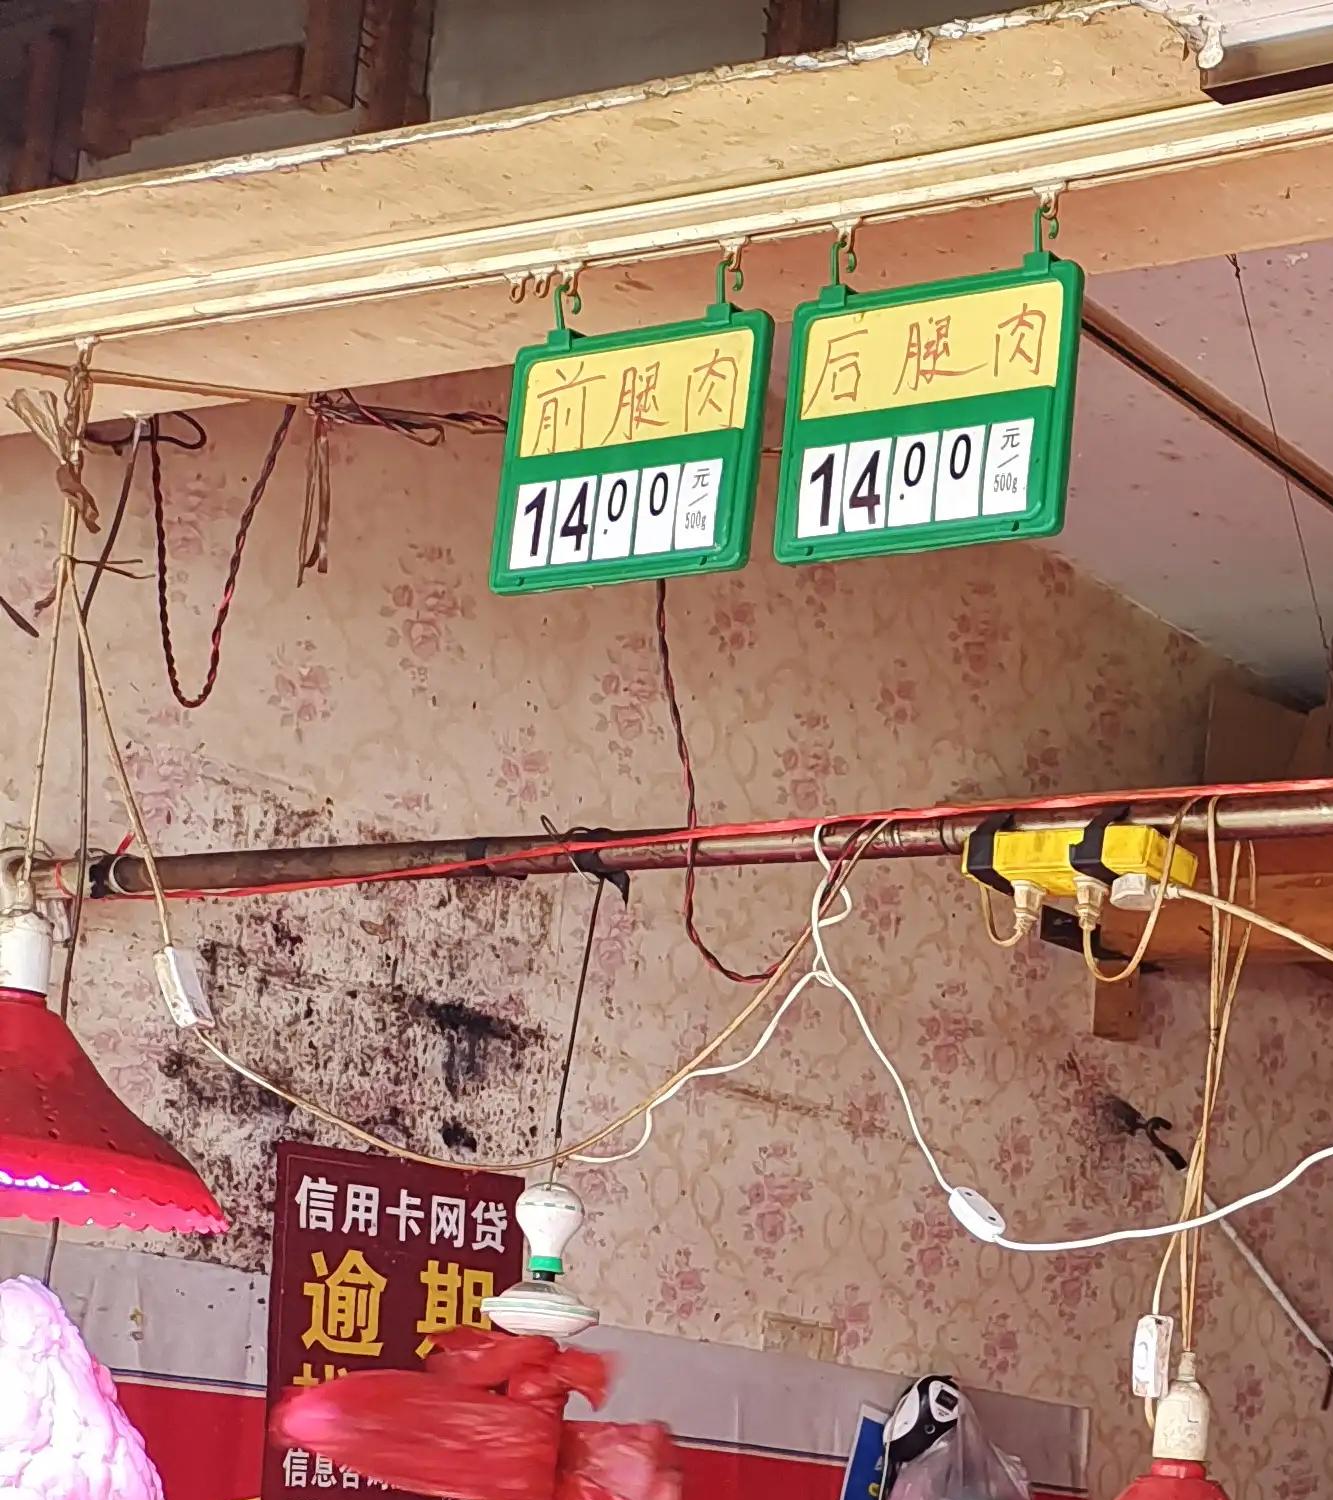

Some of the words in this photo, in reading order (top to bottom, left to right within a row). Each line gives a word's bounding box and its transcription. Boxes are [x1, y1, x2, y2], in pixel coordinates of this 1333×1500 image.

[531, 348, 739, 456] 前腿肉
[801, 301, 1047, 418] 后腿肉
[523, 471, 669, 557] 14.00
[808, 432, 972, 527] 14.00
[294, 1175, 509, 1253] 信用卡网贷
[302, 1248, 495, 1359] 逾期
[282, 1447, 389, 1491] 信息咨
